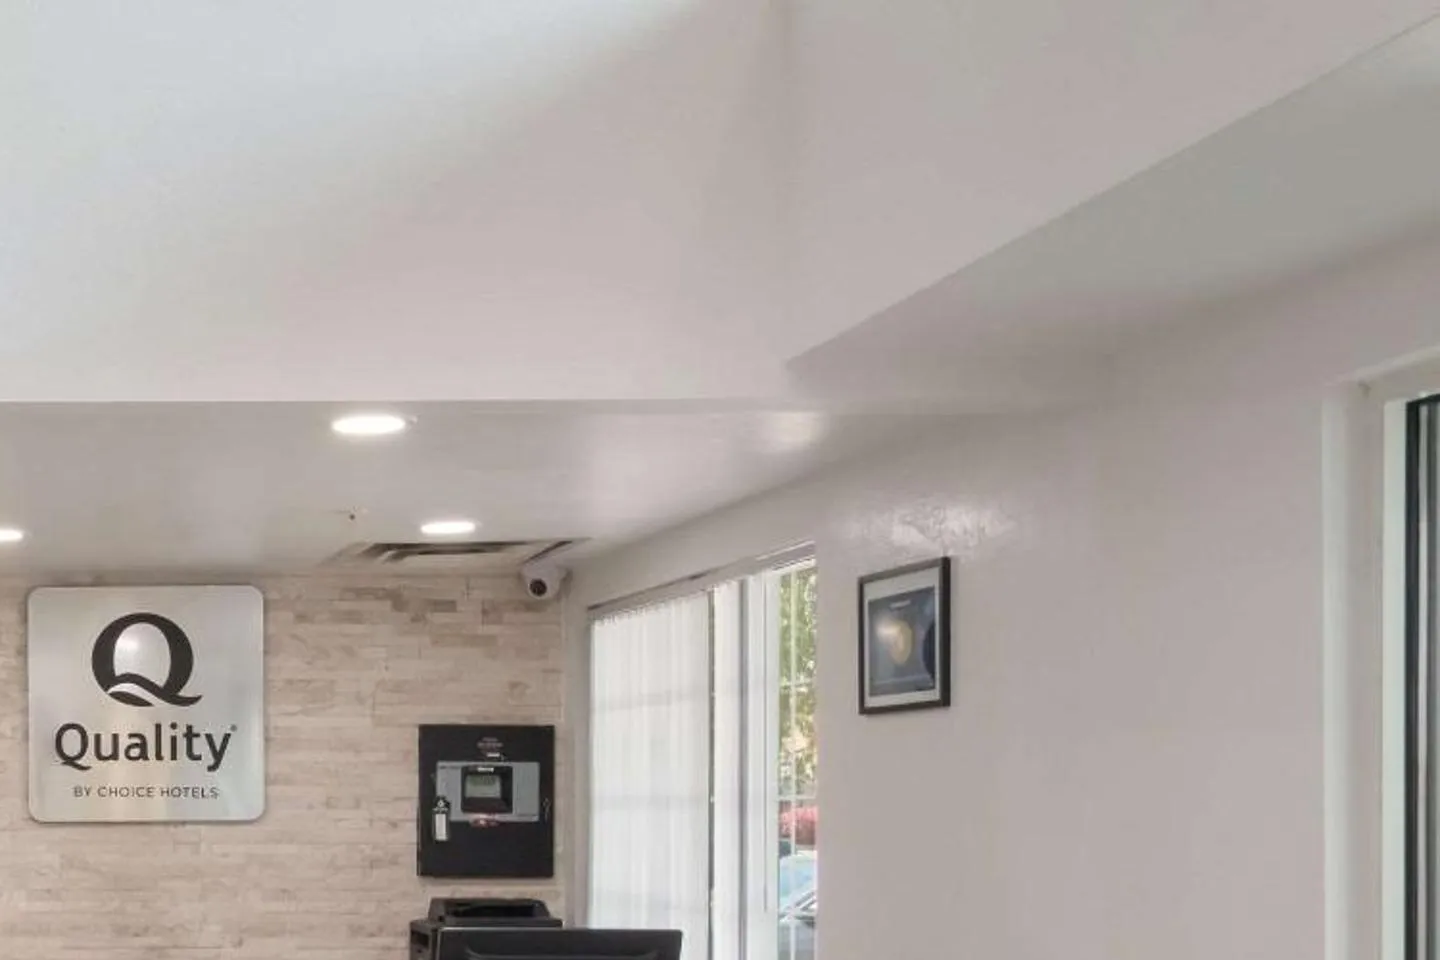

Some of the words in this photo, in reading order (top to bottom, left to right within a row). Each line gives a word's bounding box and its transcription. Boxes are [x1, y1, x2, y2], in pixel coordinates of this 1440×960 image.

[91, 612, 203, 707] Q
[54, 721, 233, 772] Quality
[73, 786, 91, 798] BY
[97, 786, 155, 798] CHOICE
[160, 786, 220, 799] HOTELS
